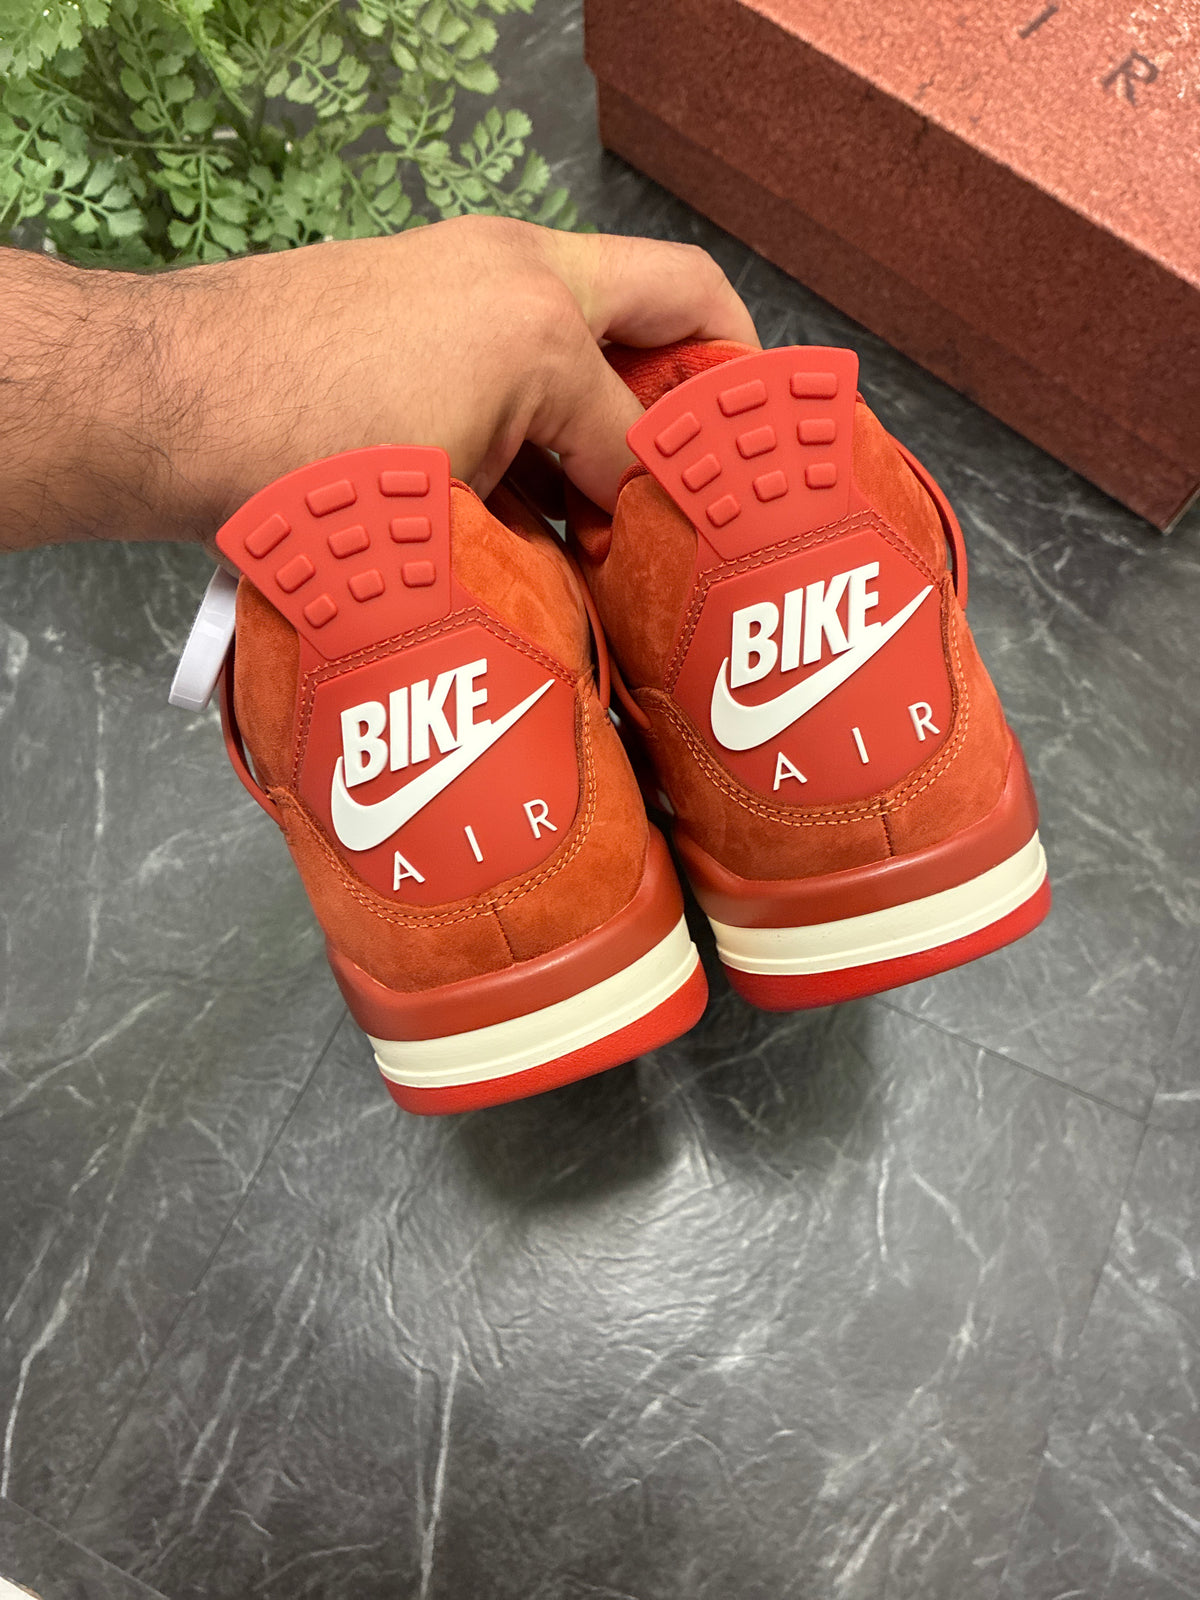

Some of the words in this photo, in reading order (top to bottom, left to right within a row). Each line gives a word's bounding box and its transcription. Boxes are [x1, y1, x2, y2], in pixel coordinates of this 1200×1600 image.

[731, 561, 883, 689] BIKE
[340, 658, 492, 788] BIKE
[773, 701, 941, 791] AIR
[392, 798, 557, 892] AIR
